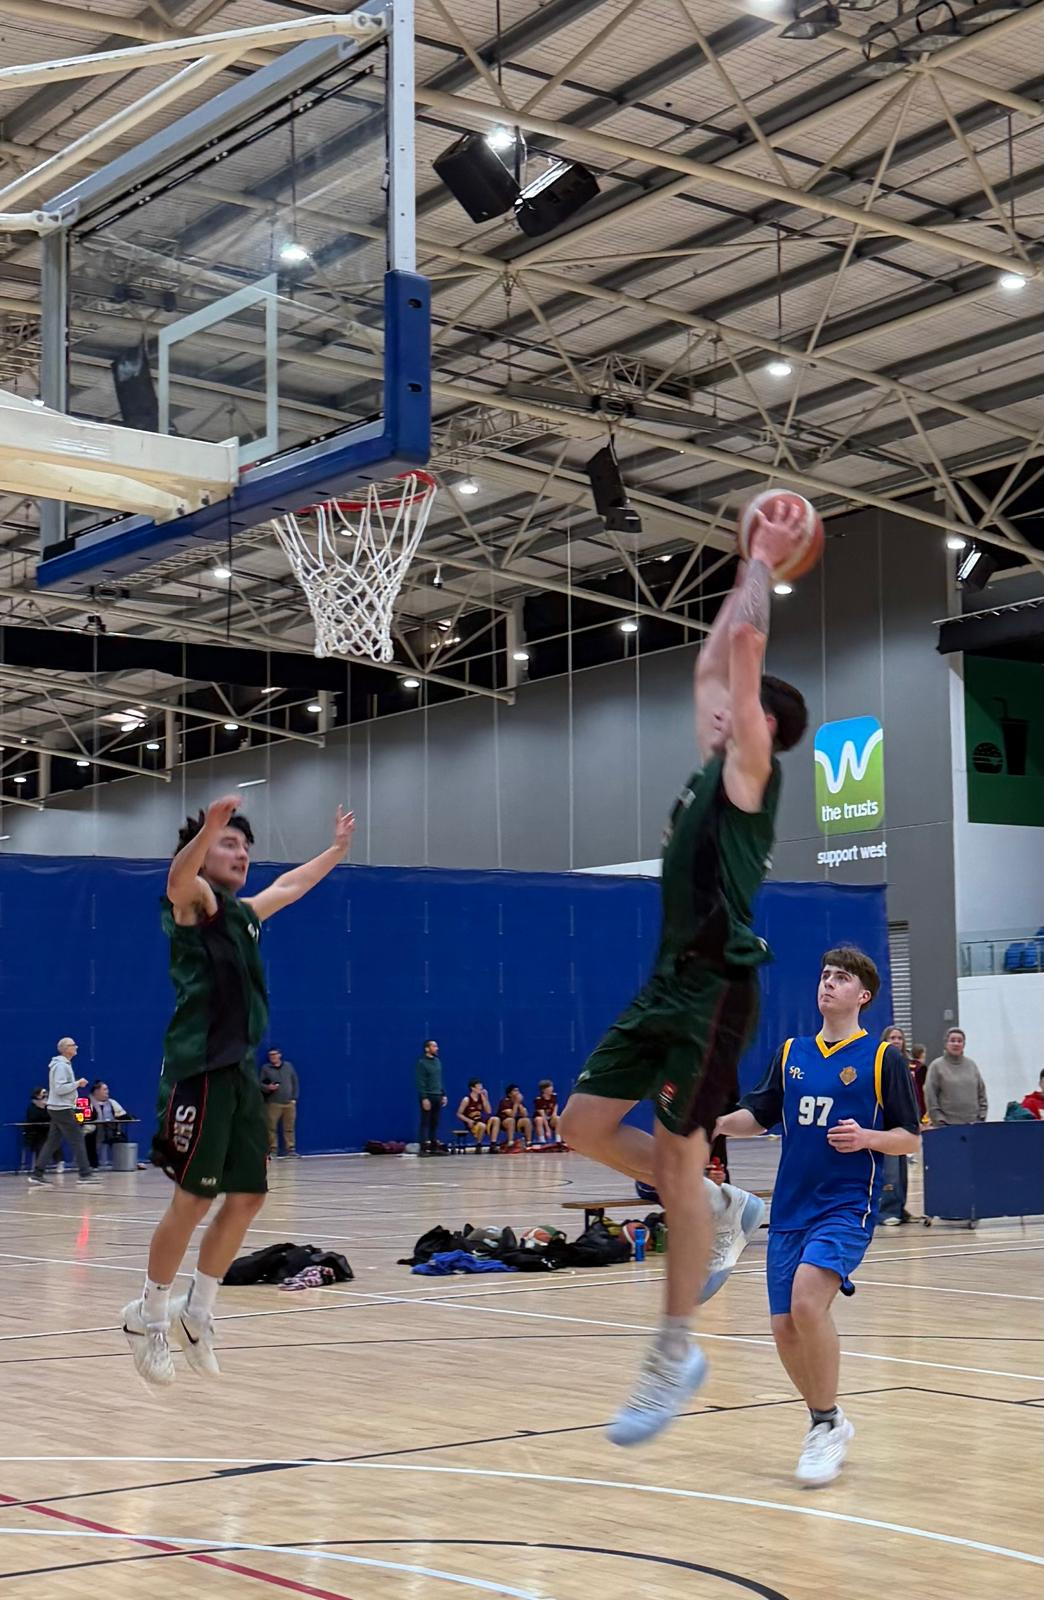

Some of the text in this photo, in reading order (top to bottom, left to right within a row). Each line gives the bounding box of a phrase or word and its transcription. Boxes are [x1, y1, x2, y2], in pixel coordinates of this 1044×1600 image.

[821, 799, 879, 822] the trusts
[817, 841, 887, 867] support west
[798, 1095, 834, 1127] 97
